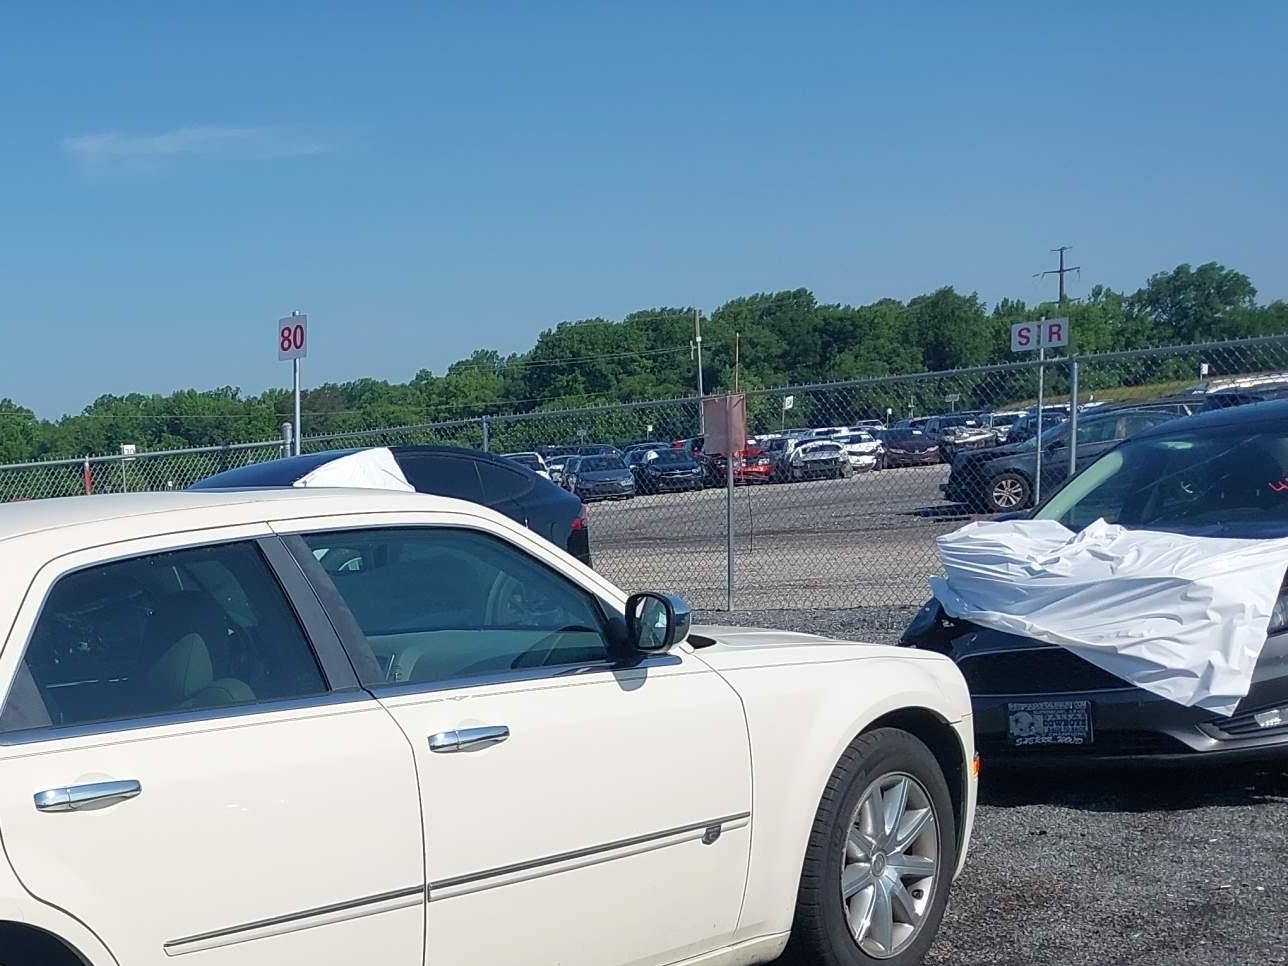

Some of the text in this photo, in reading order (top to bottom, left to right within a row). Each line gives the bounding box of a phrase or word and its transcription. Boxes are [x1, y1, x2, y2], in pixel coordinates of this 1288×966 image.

[280, 324, 304, 352] 80
[1017, 323, 1062, 346] S R
